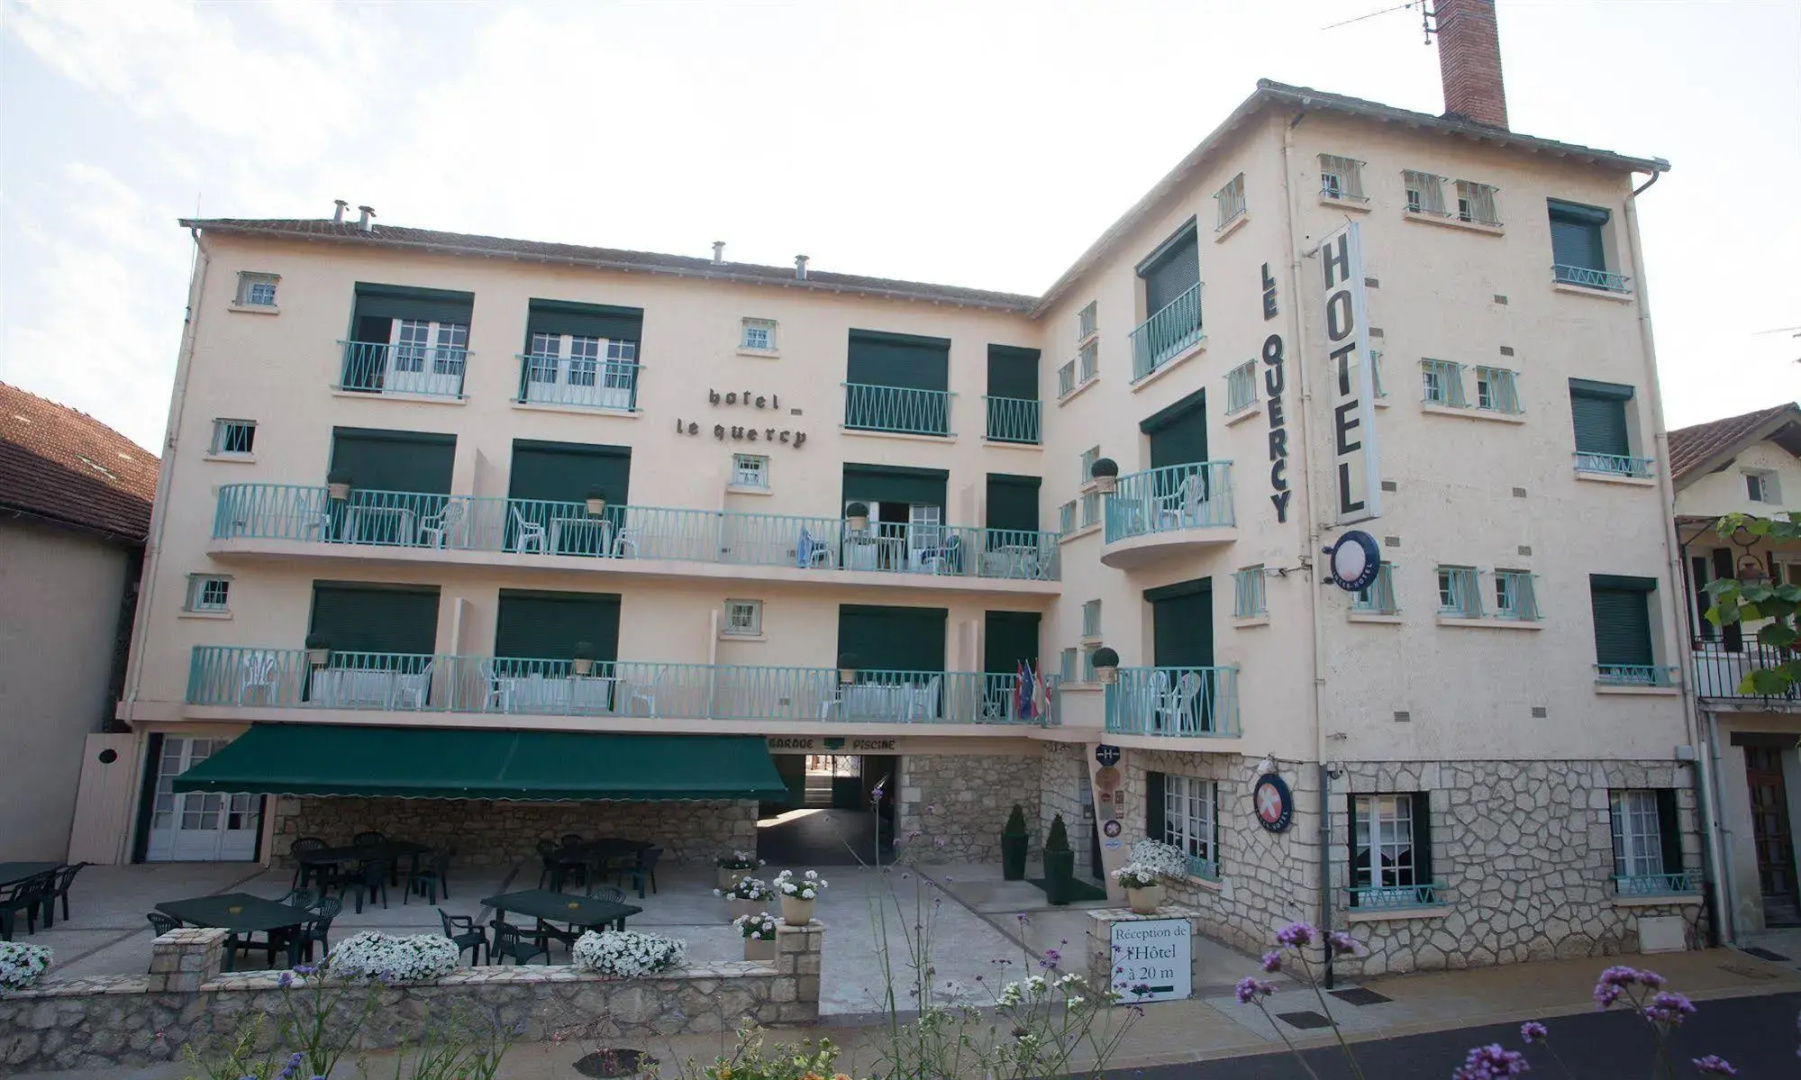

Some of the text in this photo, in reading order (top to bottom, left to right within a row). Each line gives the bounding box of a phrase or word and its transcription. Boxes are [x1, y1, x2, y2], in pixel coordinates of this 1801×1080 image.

[1261, 262, 1291, 523] LE QUERCY
[1322, 232, 1365, 515] HOTEL
[1116, 926, 1187, 941] Réception de
[1128, 967, 1174, 981] à 20 m
